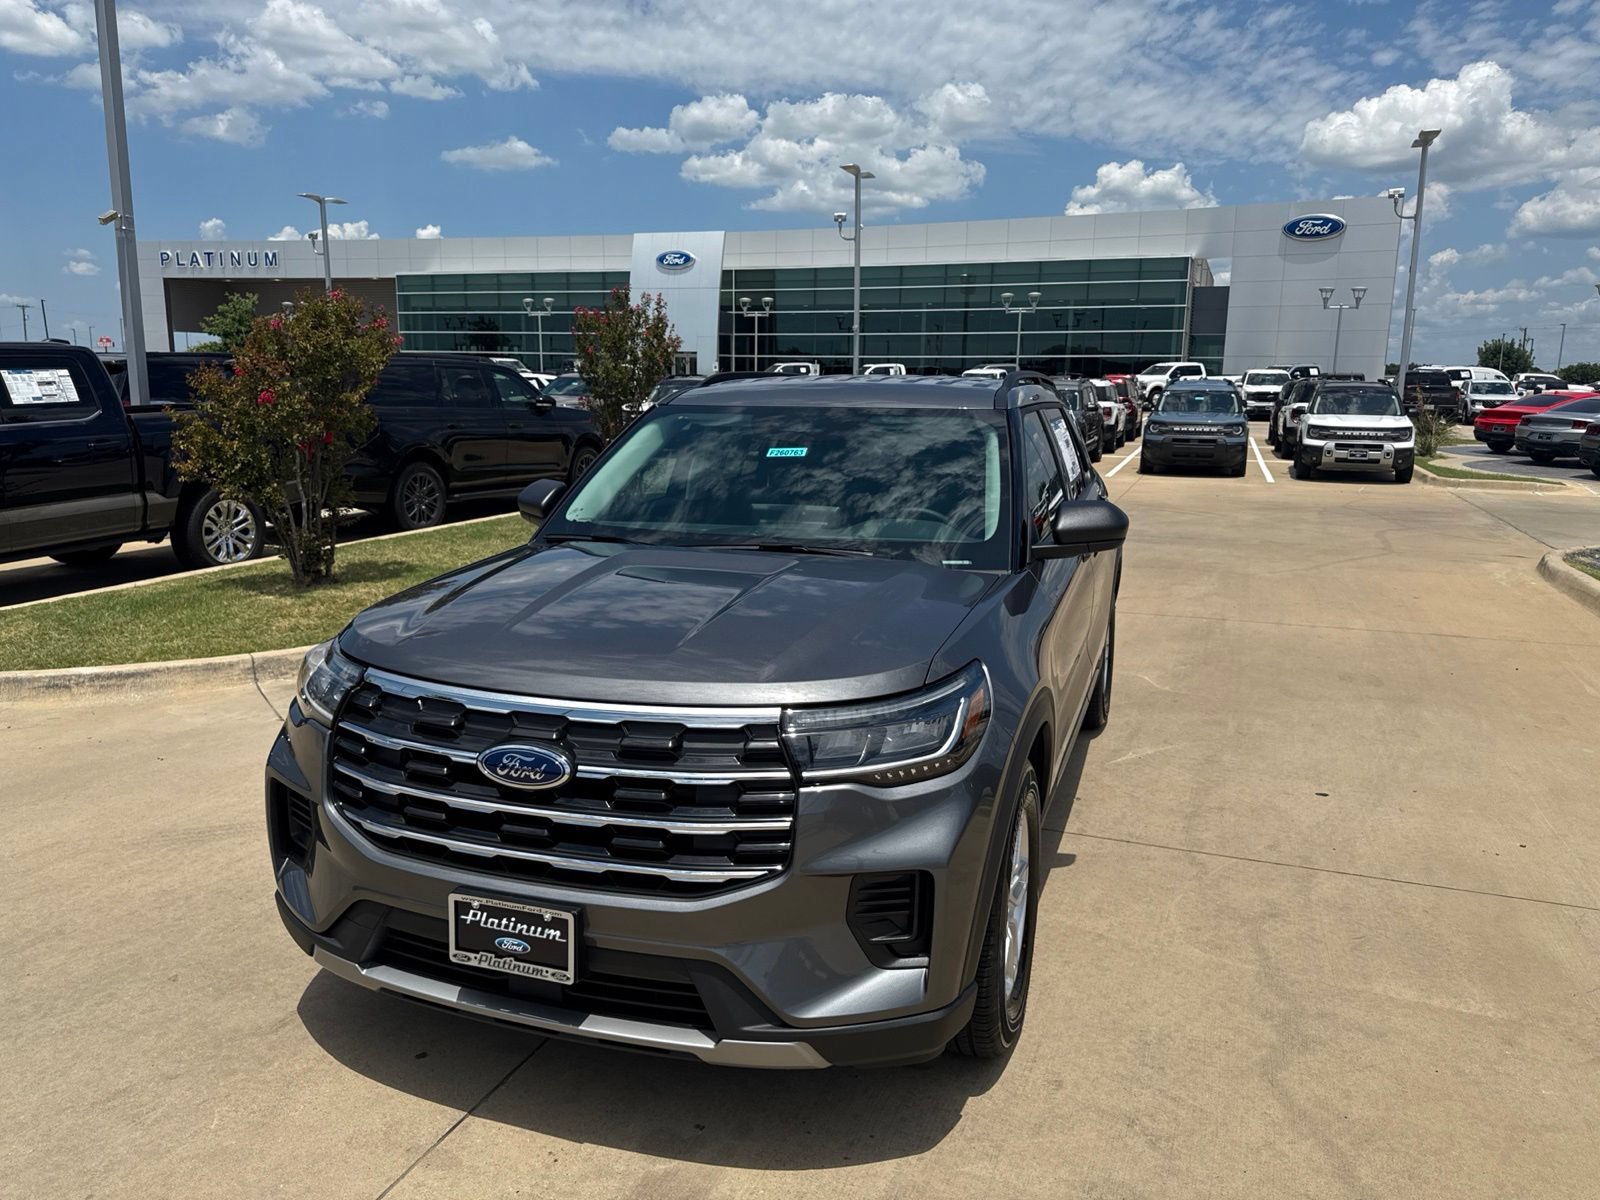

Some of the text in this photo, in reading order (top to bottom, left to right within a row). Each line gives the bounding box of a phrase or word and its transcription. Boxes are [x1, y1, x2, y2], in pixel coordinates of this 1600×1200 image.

[1295, 220, 1332, 235] Ford
[160, 251, 278, 267] PLATINUM
[663, 254, 686, 265] Ford
[496, 753, 547, 780] Ford
[460, 909, 567, 943] Platinum
[501, 940, 524, 953] Ford
[477, 953, 549, 979] Platinum
